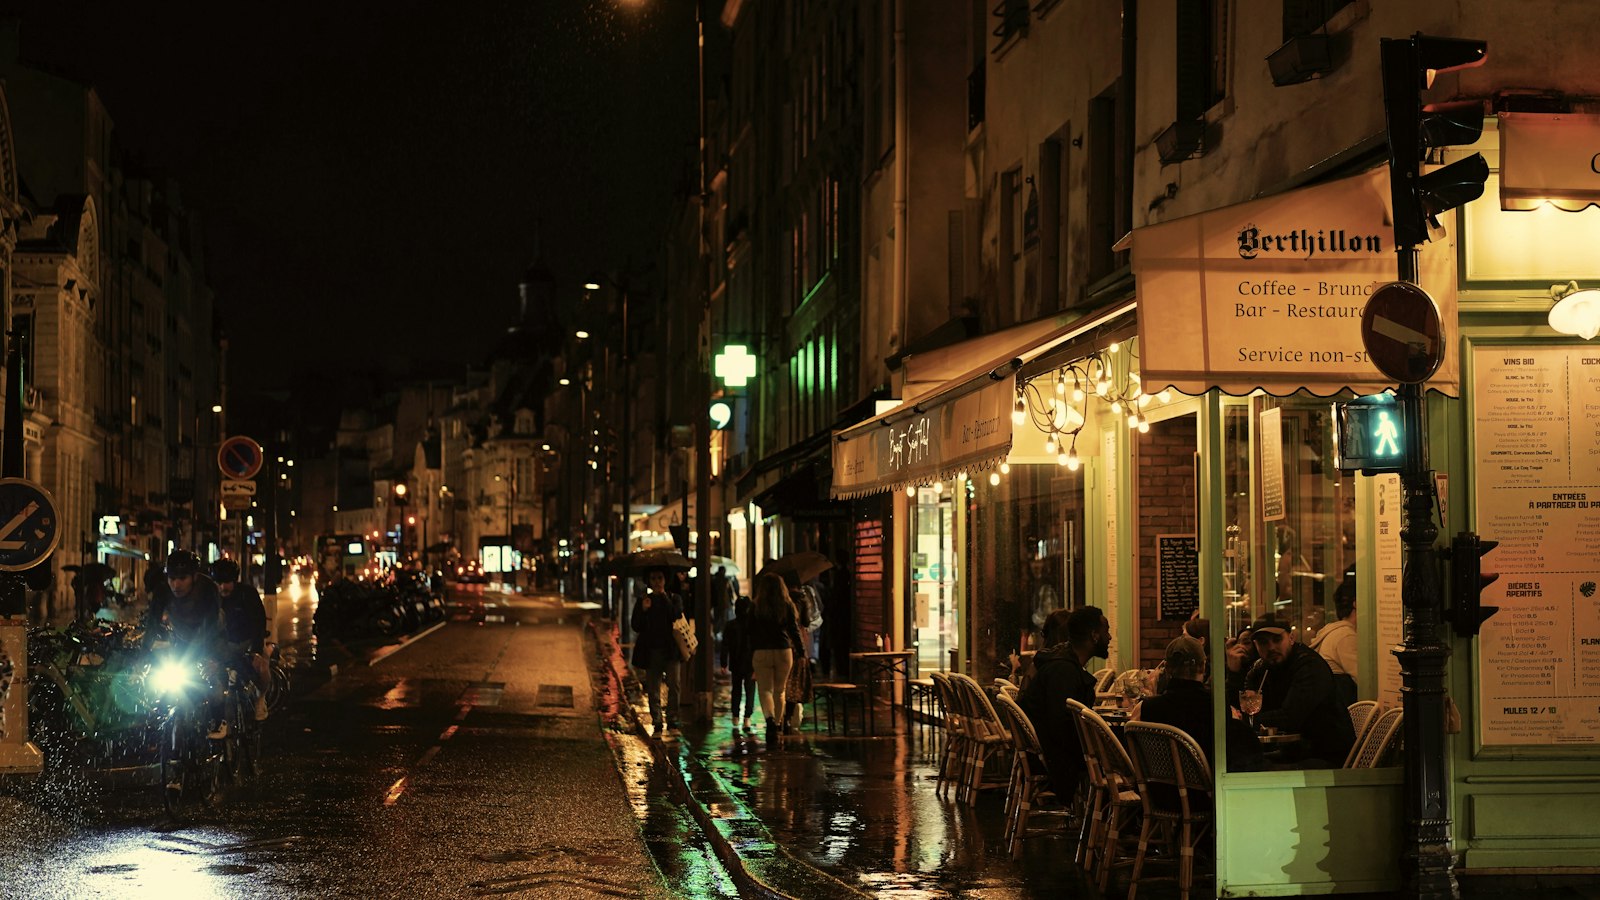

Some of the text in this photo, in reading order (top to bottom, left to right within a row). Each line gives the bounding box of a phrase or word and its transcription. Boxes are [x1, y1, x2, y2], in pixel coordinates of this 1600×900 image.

[1238, 223, 1381, 261] Berthillon
[1238, 281, 1296, 296] Coffee
[1318, 281, 1377, 296] Brunc
[1235, 303, 1266, 318] Bar
[1238, 346, 1369, 362] Service non-st
[1503, 358, 1535, 366] VINS BIO
